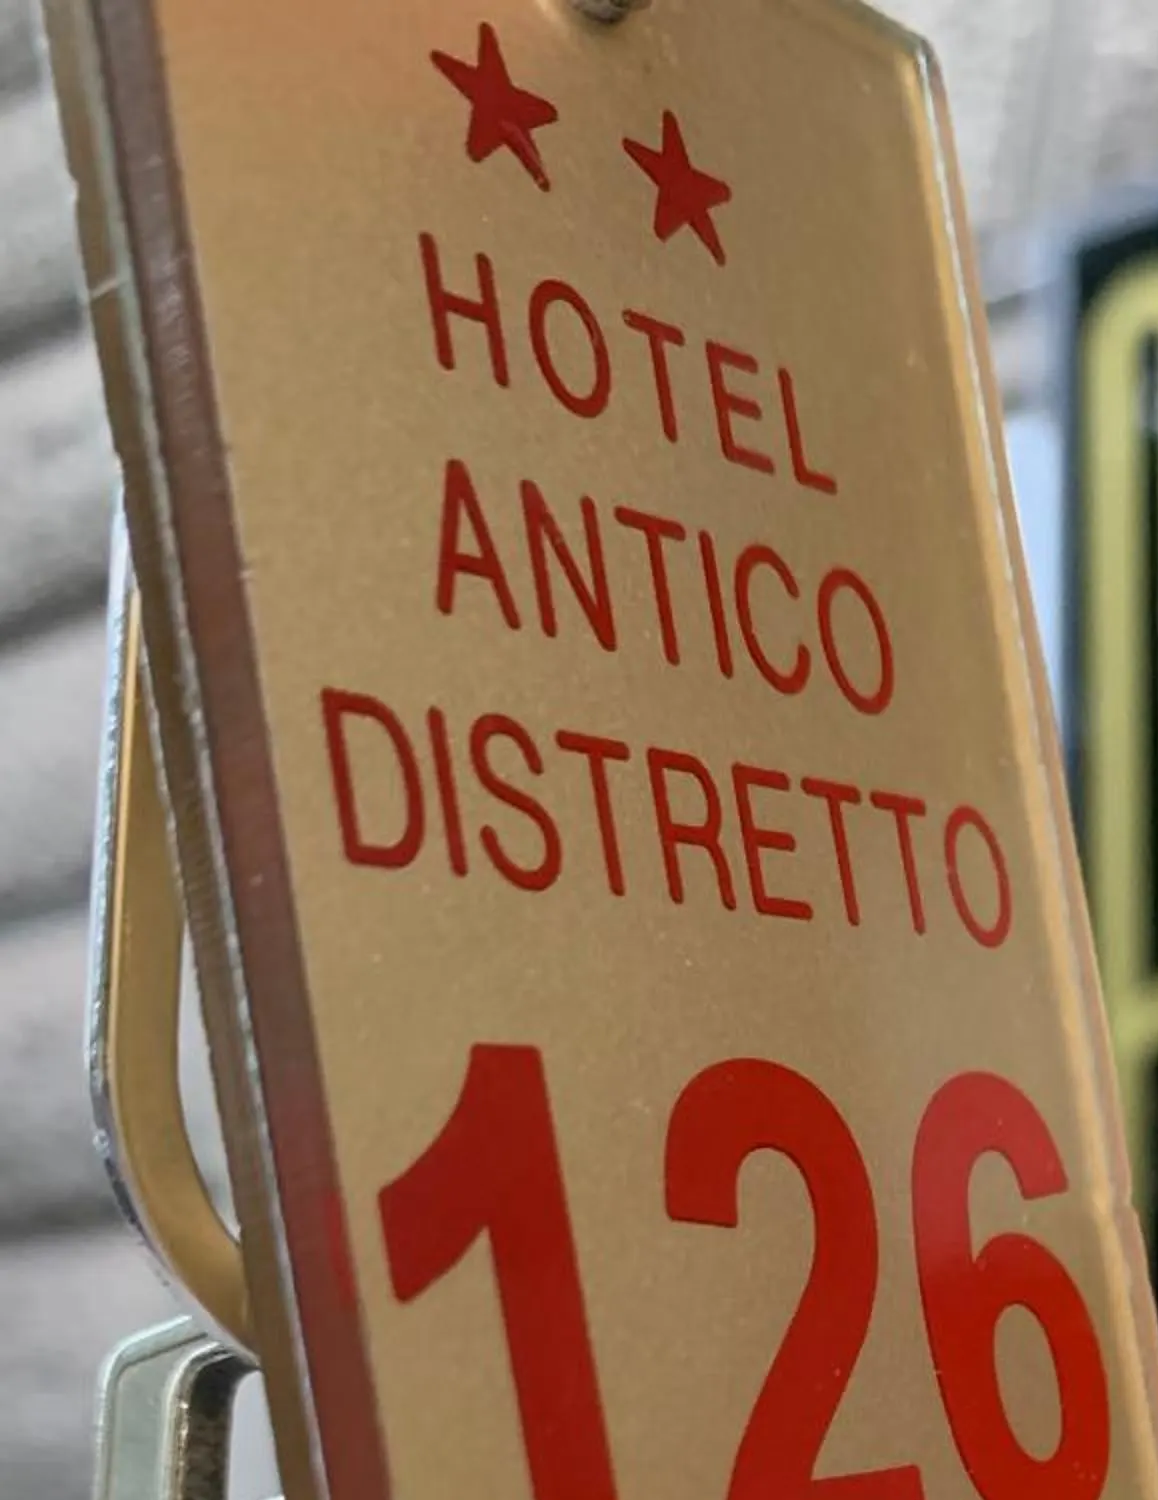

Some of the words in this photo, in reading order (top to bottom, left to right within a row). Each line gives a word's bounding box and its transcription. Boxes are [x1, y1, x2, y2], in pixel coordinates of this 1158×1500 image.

[420, 231, 838, 494] HOTEL
[435, 458, 895, 716] ANTICO
[320, 687, 1013, 948] DISTRETTO
